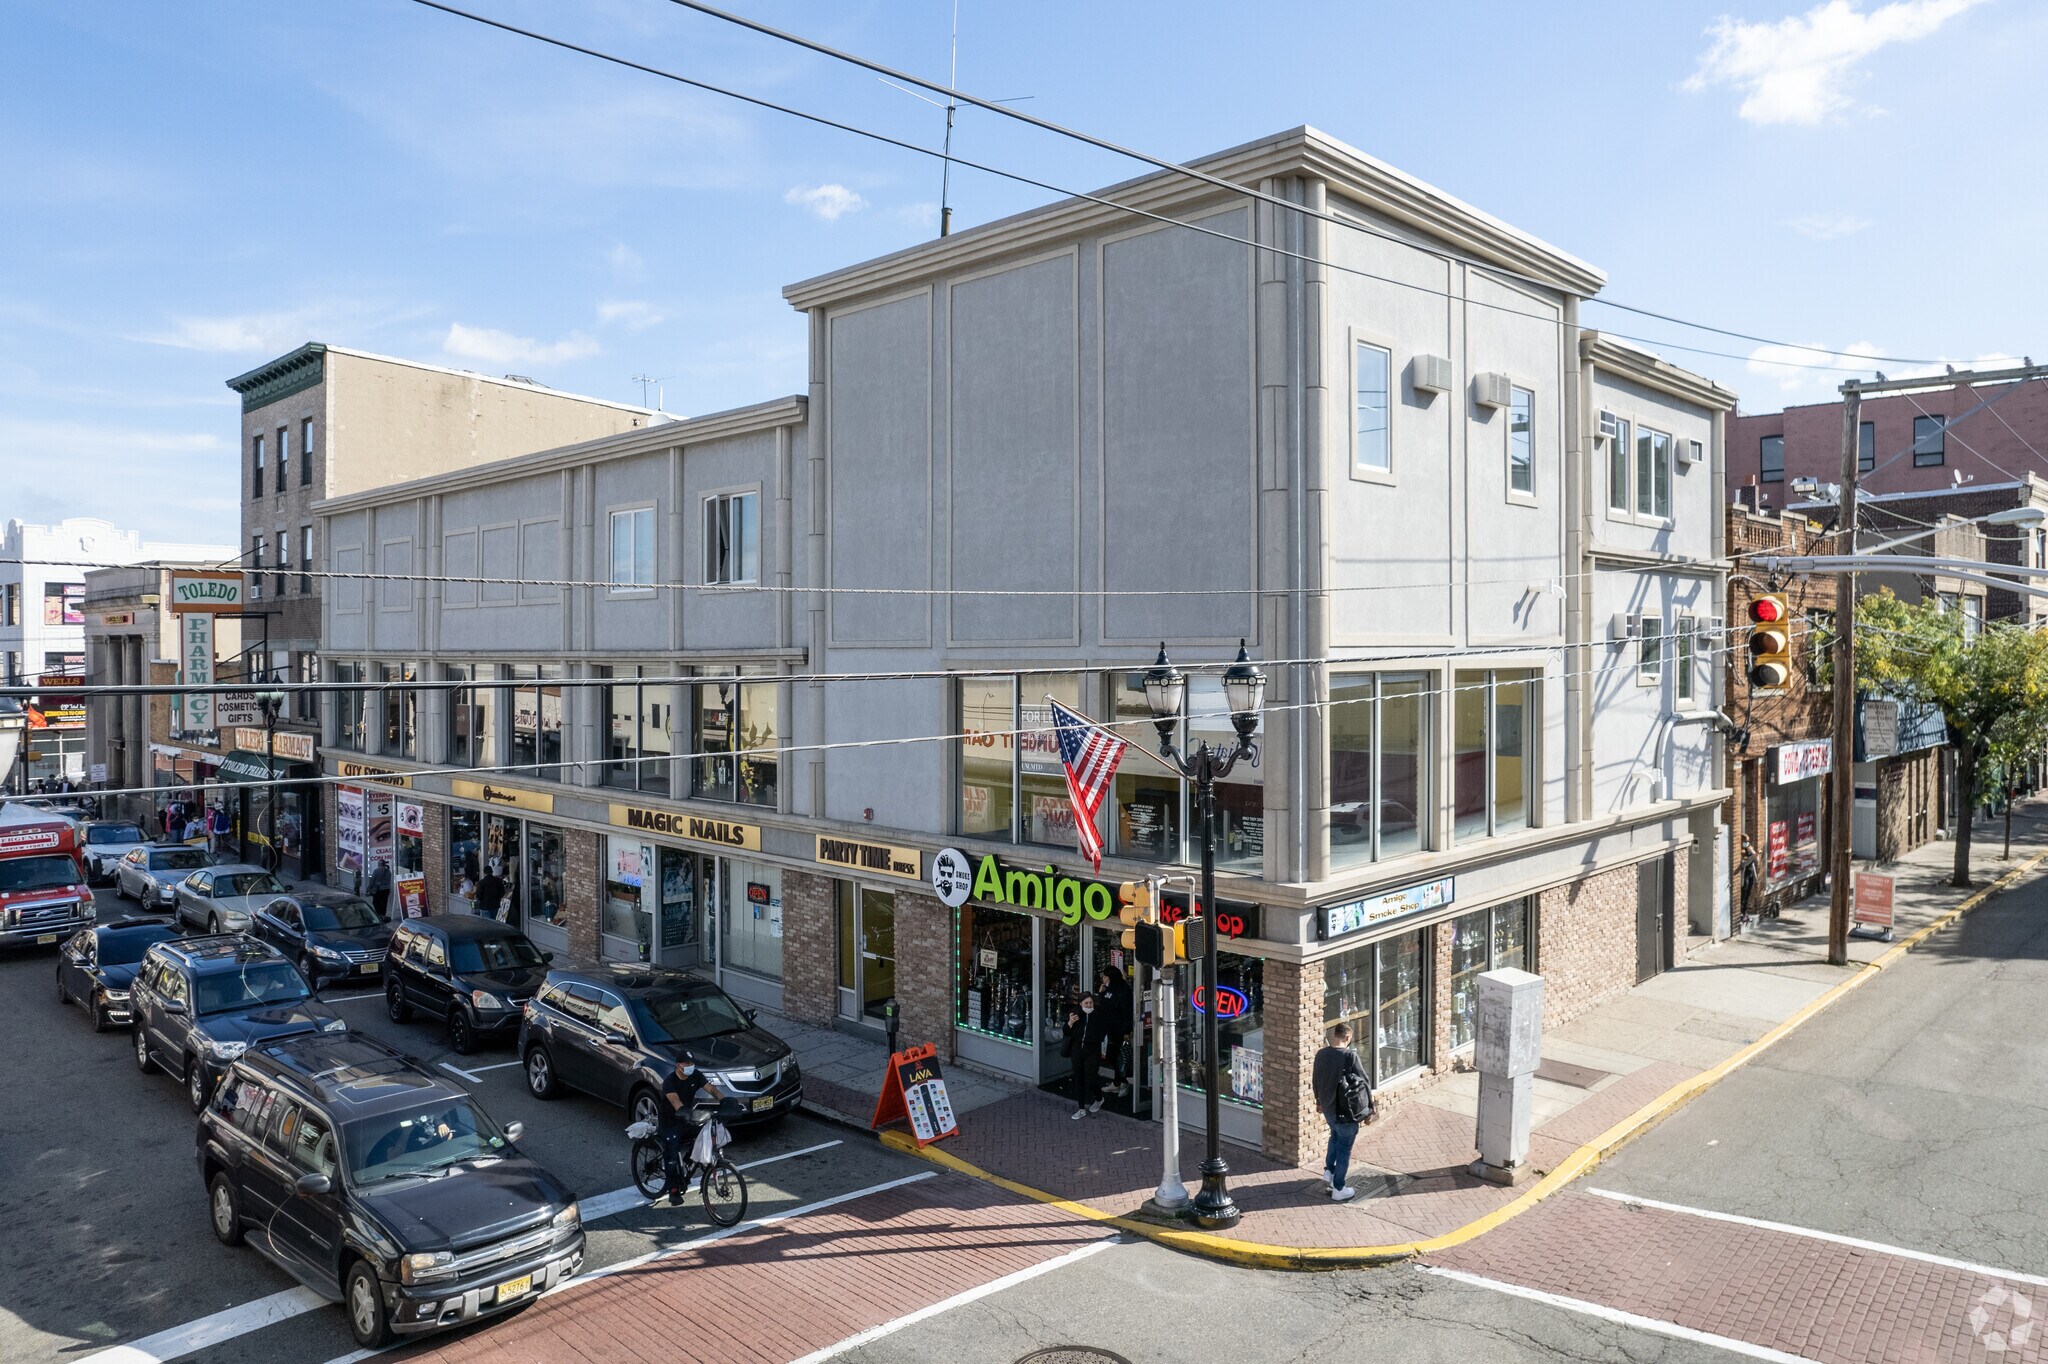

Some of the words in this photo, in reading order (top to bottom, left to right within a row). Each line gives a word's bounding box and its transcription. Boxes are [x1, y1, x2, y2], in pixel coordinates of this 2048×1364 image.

[178, 582, 237, 601] TOLEDO
[189, 618, 209, 724] PHARMCY
[225, 691, 255, 700] CARDS
[218, 702, 261, 712] COSMETICS
[228, 713, 253, 723] GIFTS
[1021, 711, 1040, 724] FOR
[238, 730, 264, 751] TOLEDO
[272, 735, 312, 758] HARMACY
[344, 763, 362, 776] CITY
[377, 803, 390, 815] $5
[628, 808, 683, 835] MAGIC
[690, 818, 744, 845] NAILS
[0, 832, 58, 843] ERGENLINE
[820, 838, 858, 864] PARTY
[860, 844, 891, 870] TIME
[893, 861, 915, 874] DRESS
[955, 870, 971, 880] SMOKE
[955, 881, 969, 891] SHOP
[973, 854, 1113, 926] Amigo
[748, 886, 767, 900] OPEN
[1382, 893, 1408, 905] Amigo
[1369, 908, 1397, 921] Smoke
[1400, 901, 1420, 913] Shop
[909, 1068, 933, 1083] LAVA
[508, 1281, 525, 1295] 5276
